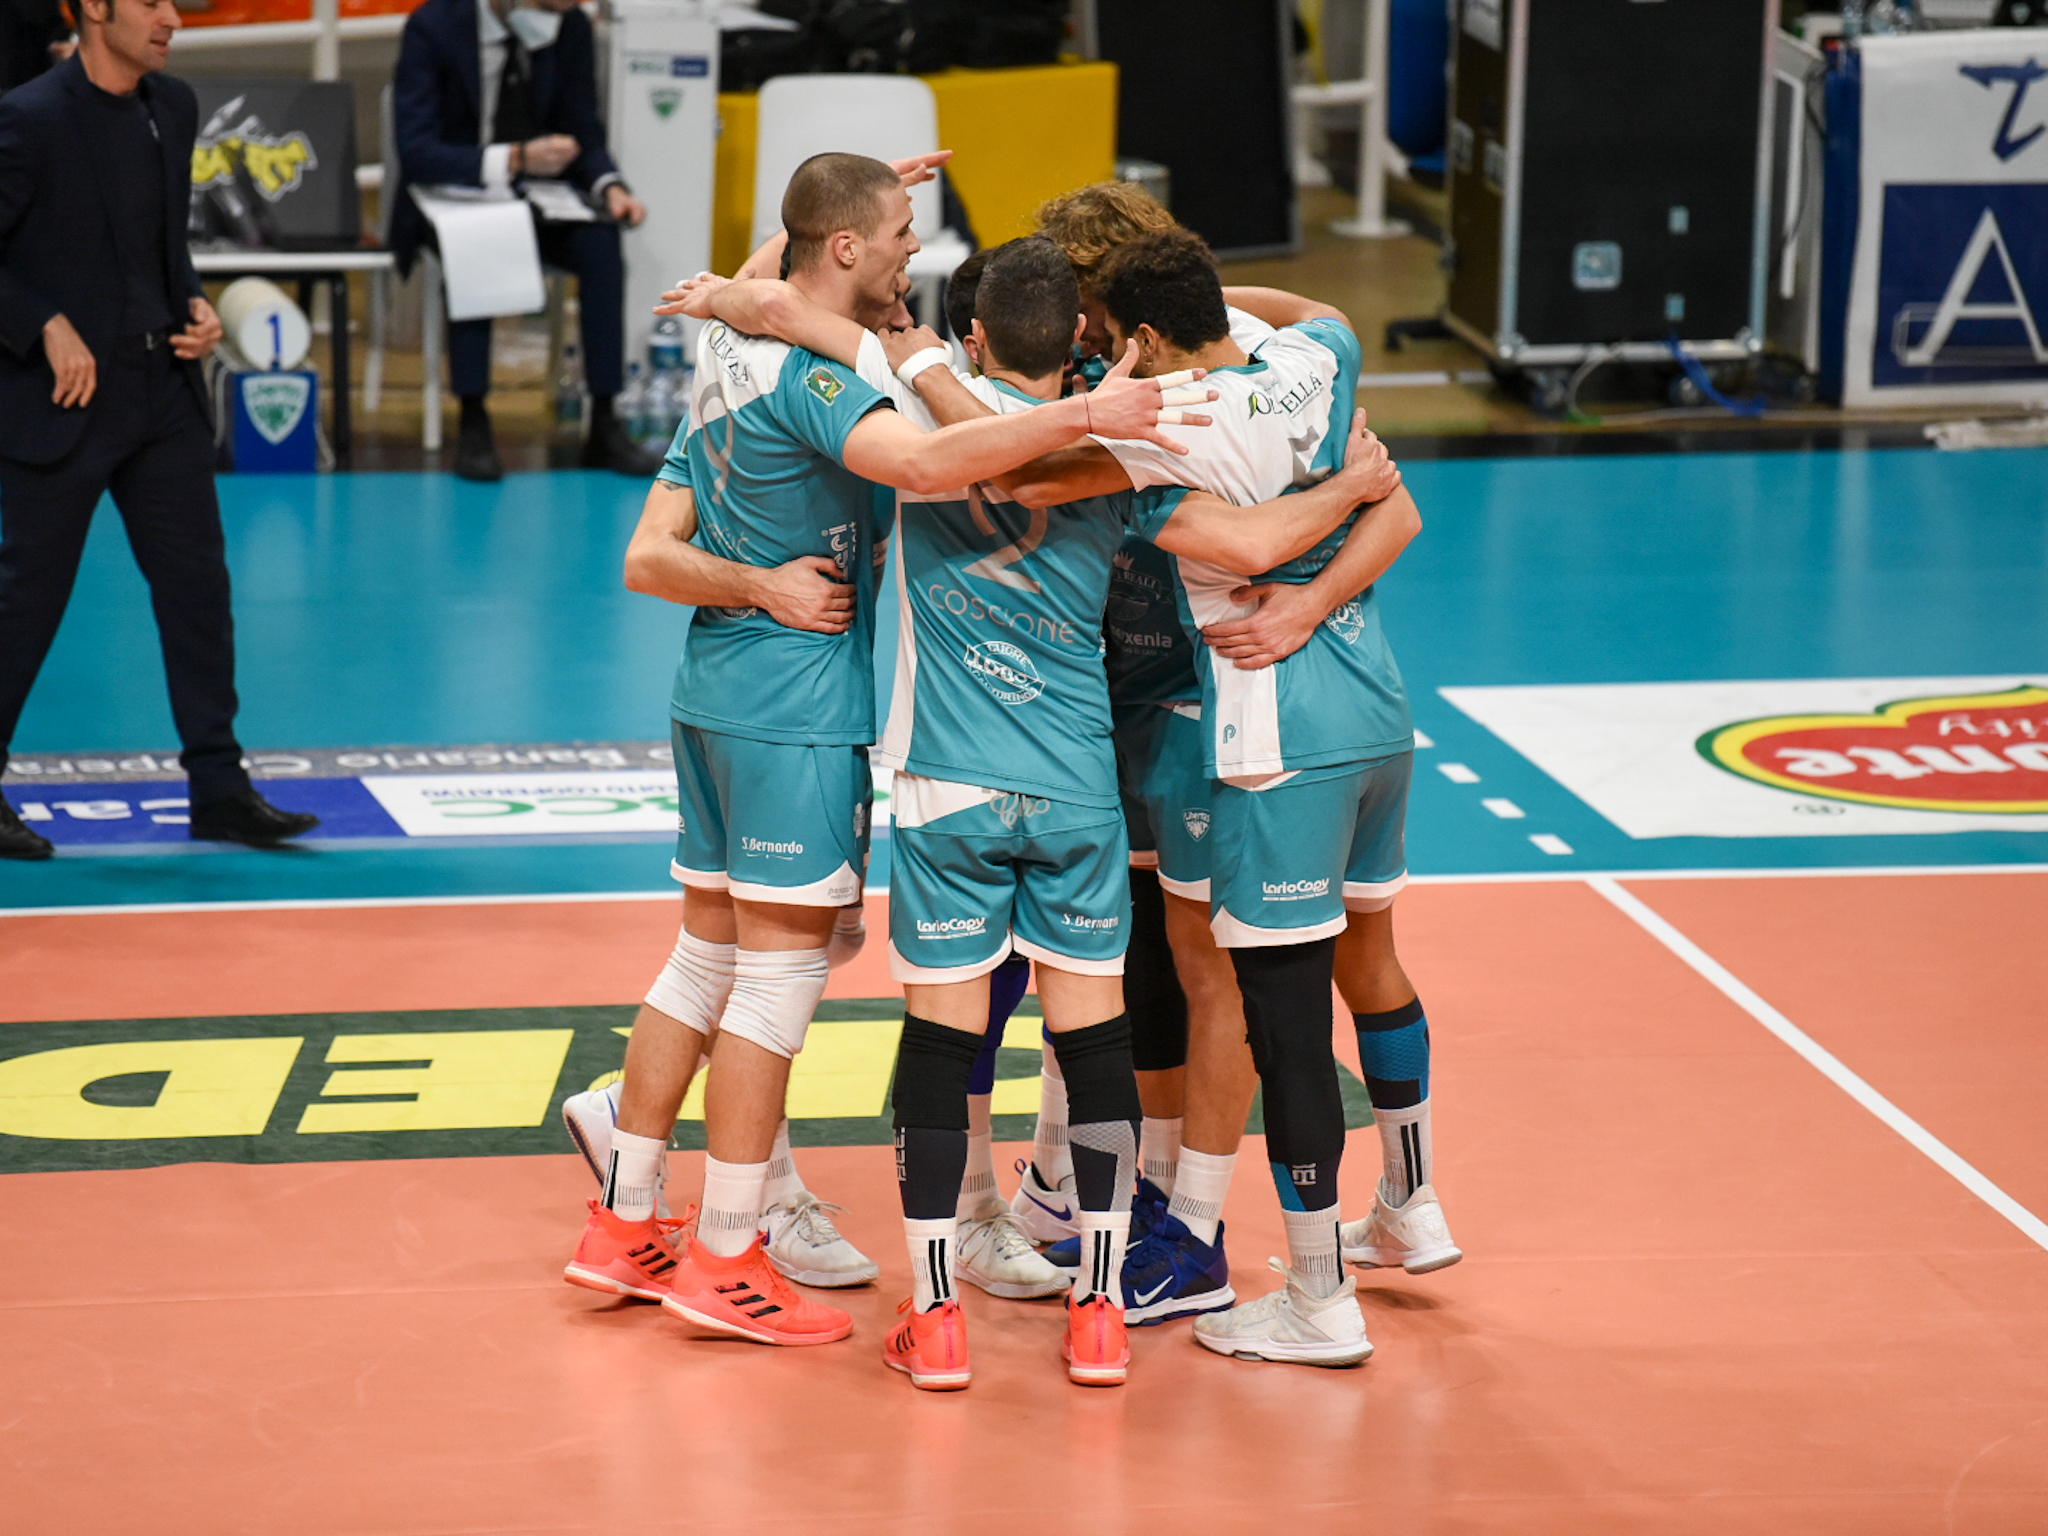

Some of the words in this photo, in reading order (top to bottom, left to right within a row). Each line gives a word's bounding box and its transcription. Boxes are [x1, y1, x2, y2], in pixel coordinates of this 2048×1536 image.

[929, 584, 1076, 643] COSCIONE
[741, 836, 804, 856] S.Bernardo
[1262, 877, 1330, 895] LarioCopy
[916, 916, 987, 932] LarioCopy
